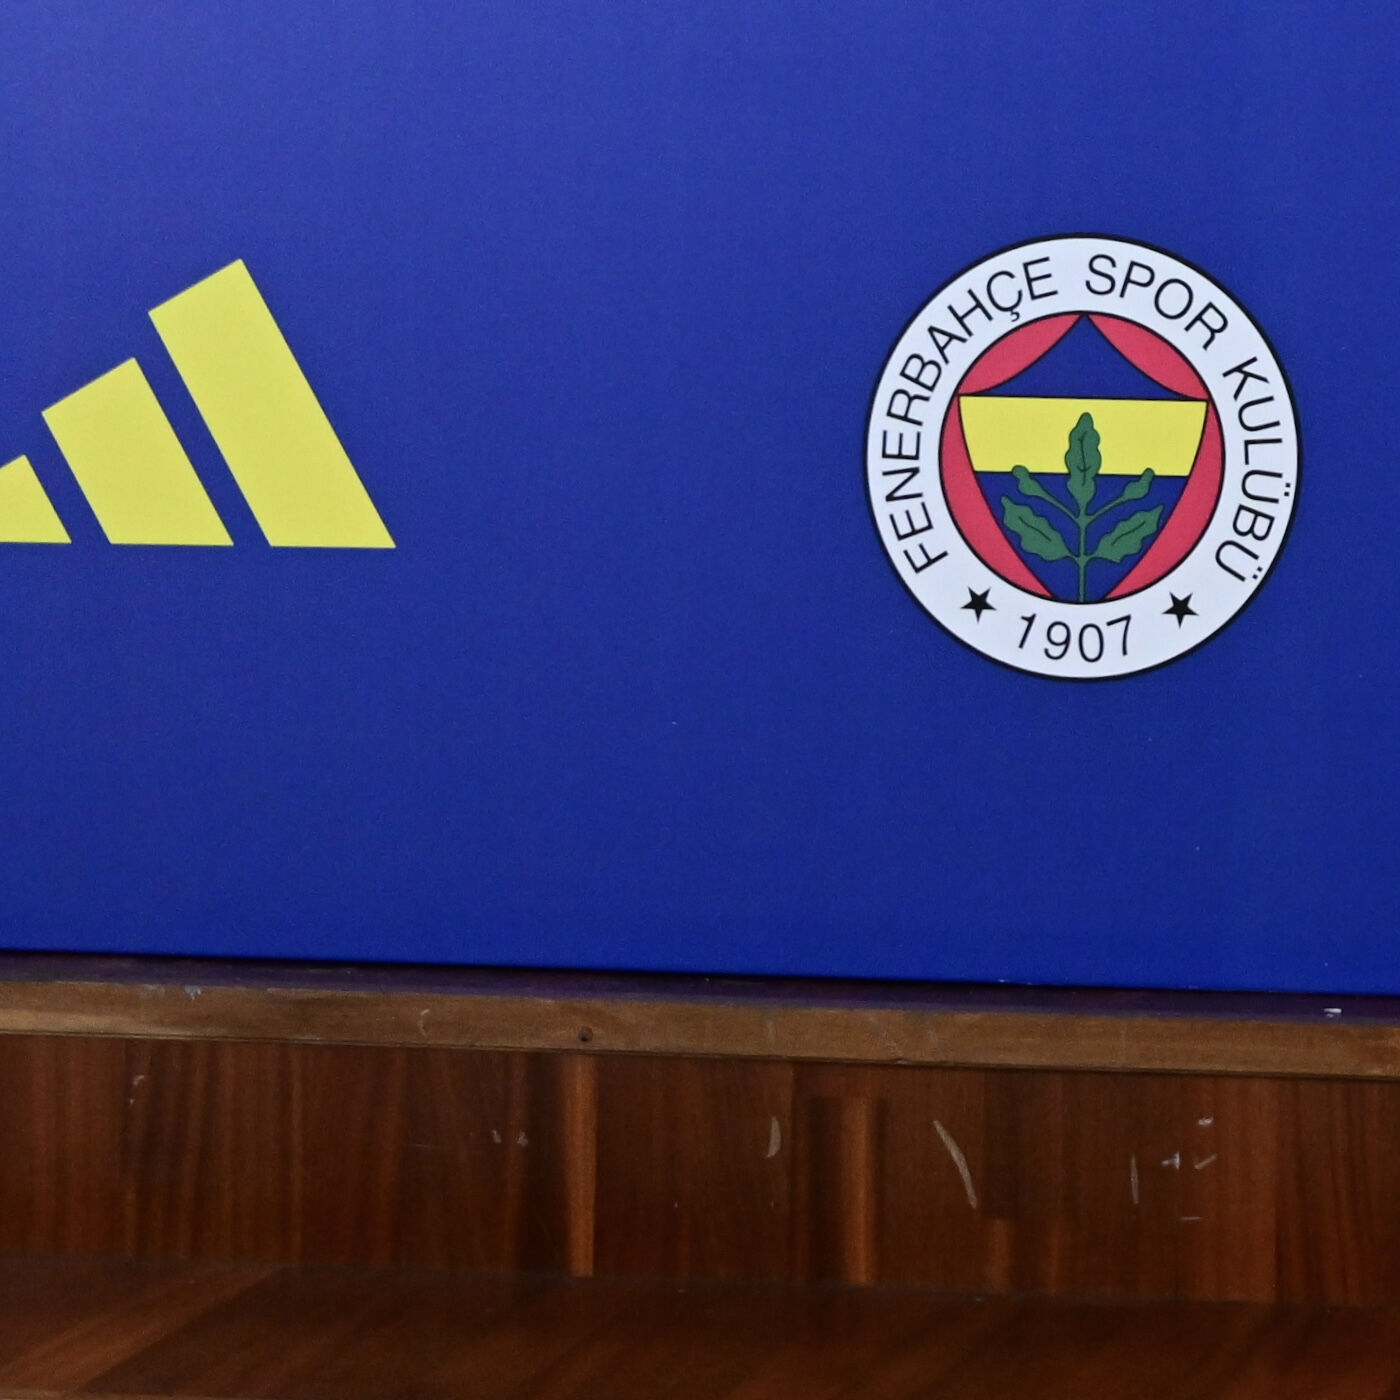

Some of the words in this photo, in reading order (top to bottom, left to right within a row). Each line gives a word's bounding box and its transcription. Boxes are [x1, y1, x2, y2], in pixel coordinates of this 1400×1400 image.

[882, 256, 1058, 574] FENERBAHÇE
[1085, 254, 1228, 351] SPOR
[1215, 356, 1291, 582] KULÜBÜ
[1017, 612, 1132, 663] 1907
